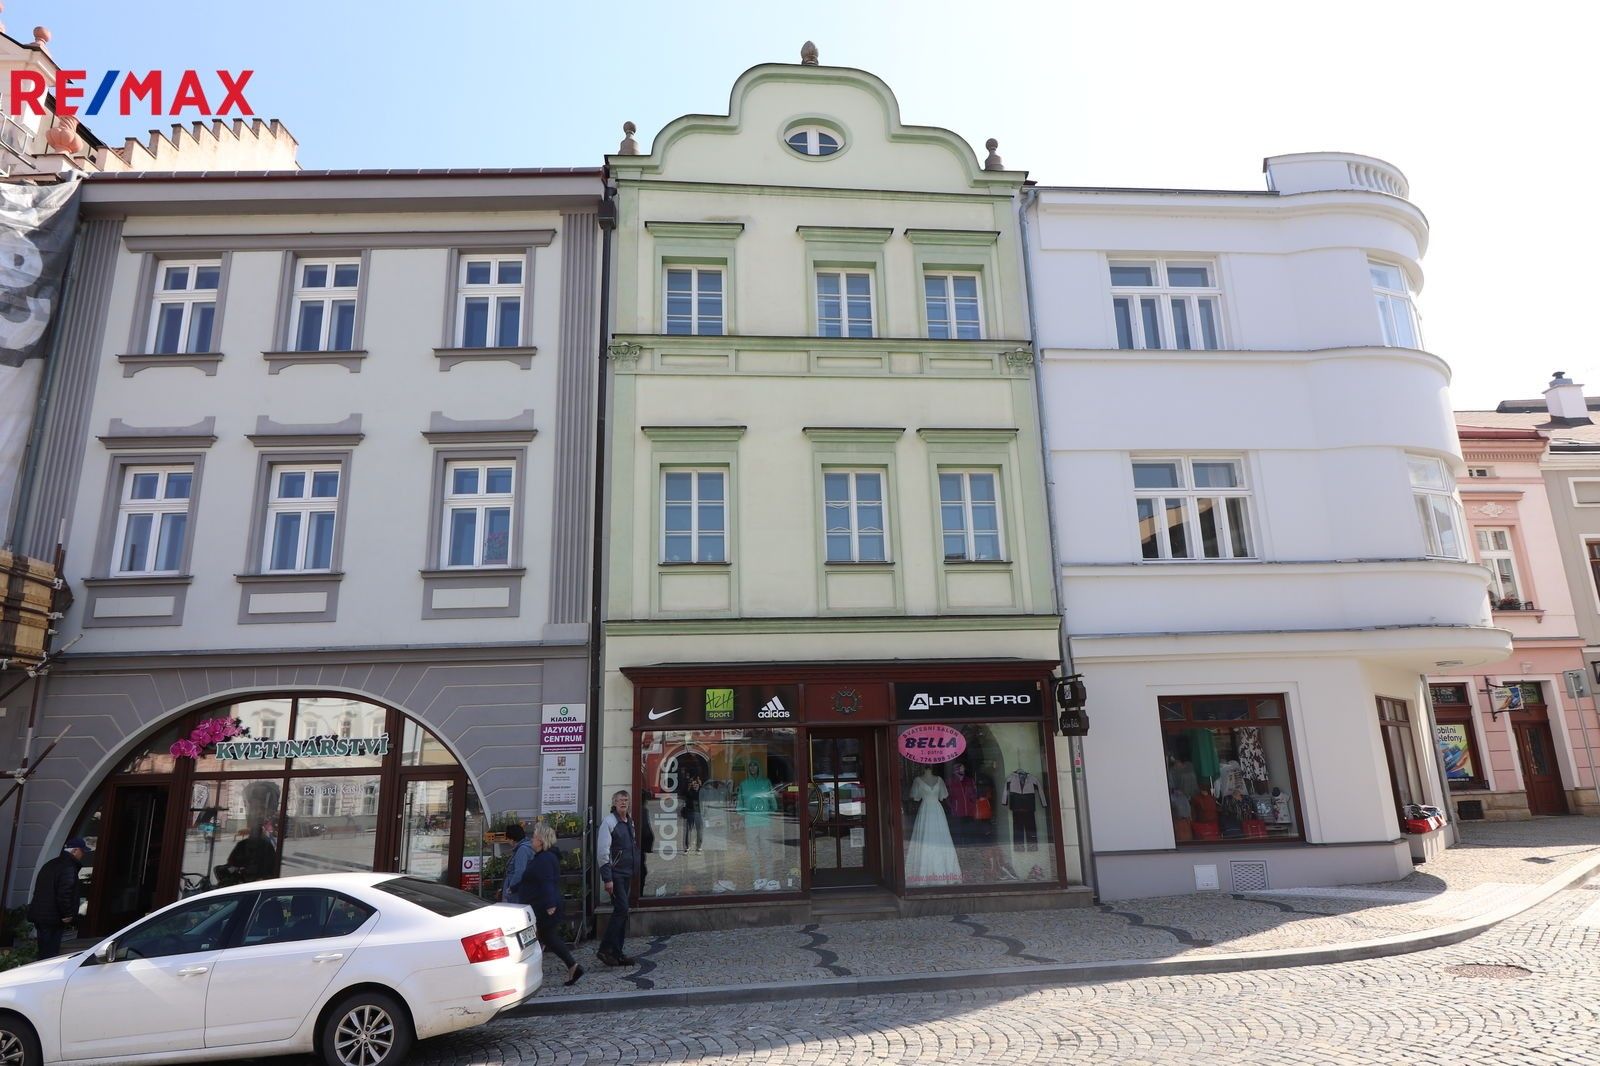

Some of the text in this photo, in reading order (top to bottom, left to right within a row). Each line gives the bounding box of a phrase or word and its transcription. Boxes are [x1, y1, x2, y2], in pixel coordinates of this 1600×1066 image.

[909, 693, 1031, 710] ALPINE PRO
[709, 711, 730, 719] sport
[757, 709, 790, 718] adidas
[543, 724, 584, 733] JAZYKOVÉ
[937, 726, 958, 737] SALON
[544, 735, 582, 743] CENTRUM
[905, 737, 957, 748] BELLA
[215, 733, 389, 760] KVĚTINÁŘSTVÍ
[303, 784, 337, 796] Edard
[654, 756, 679, 861] adidas
